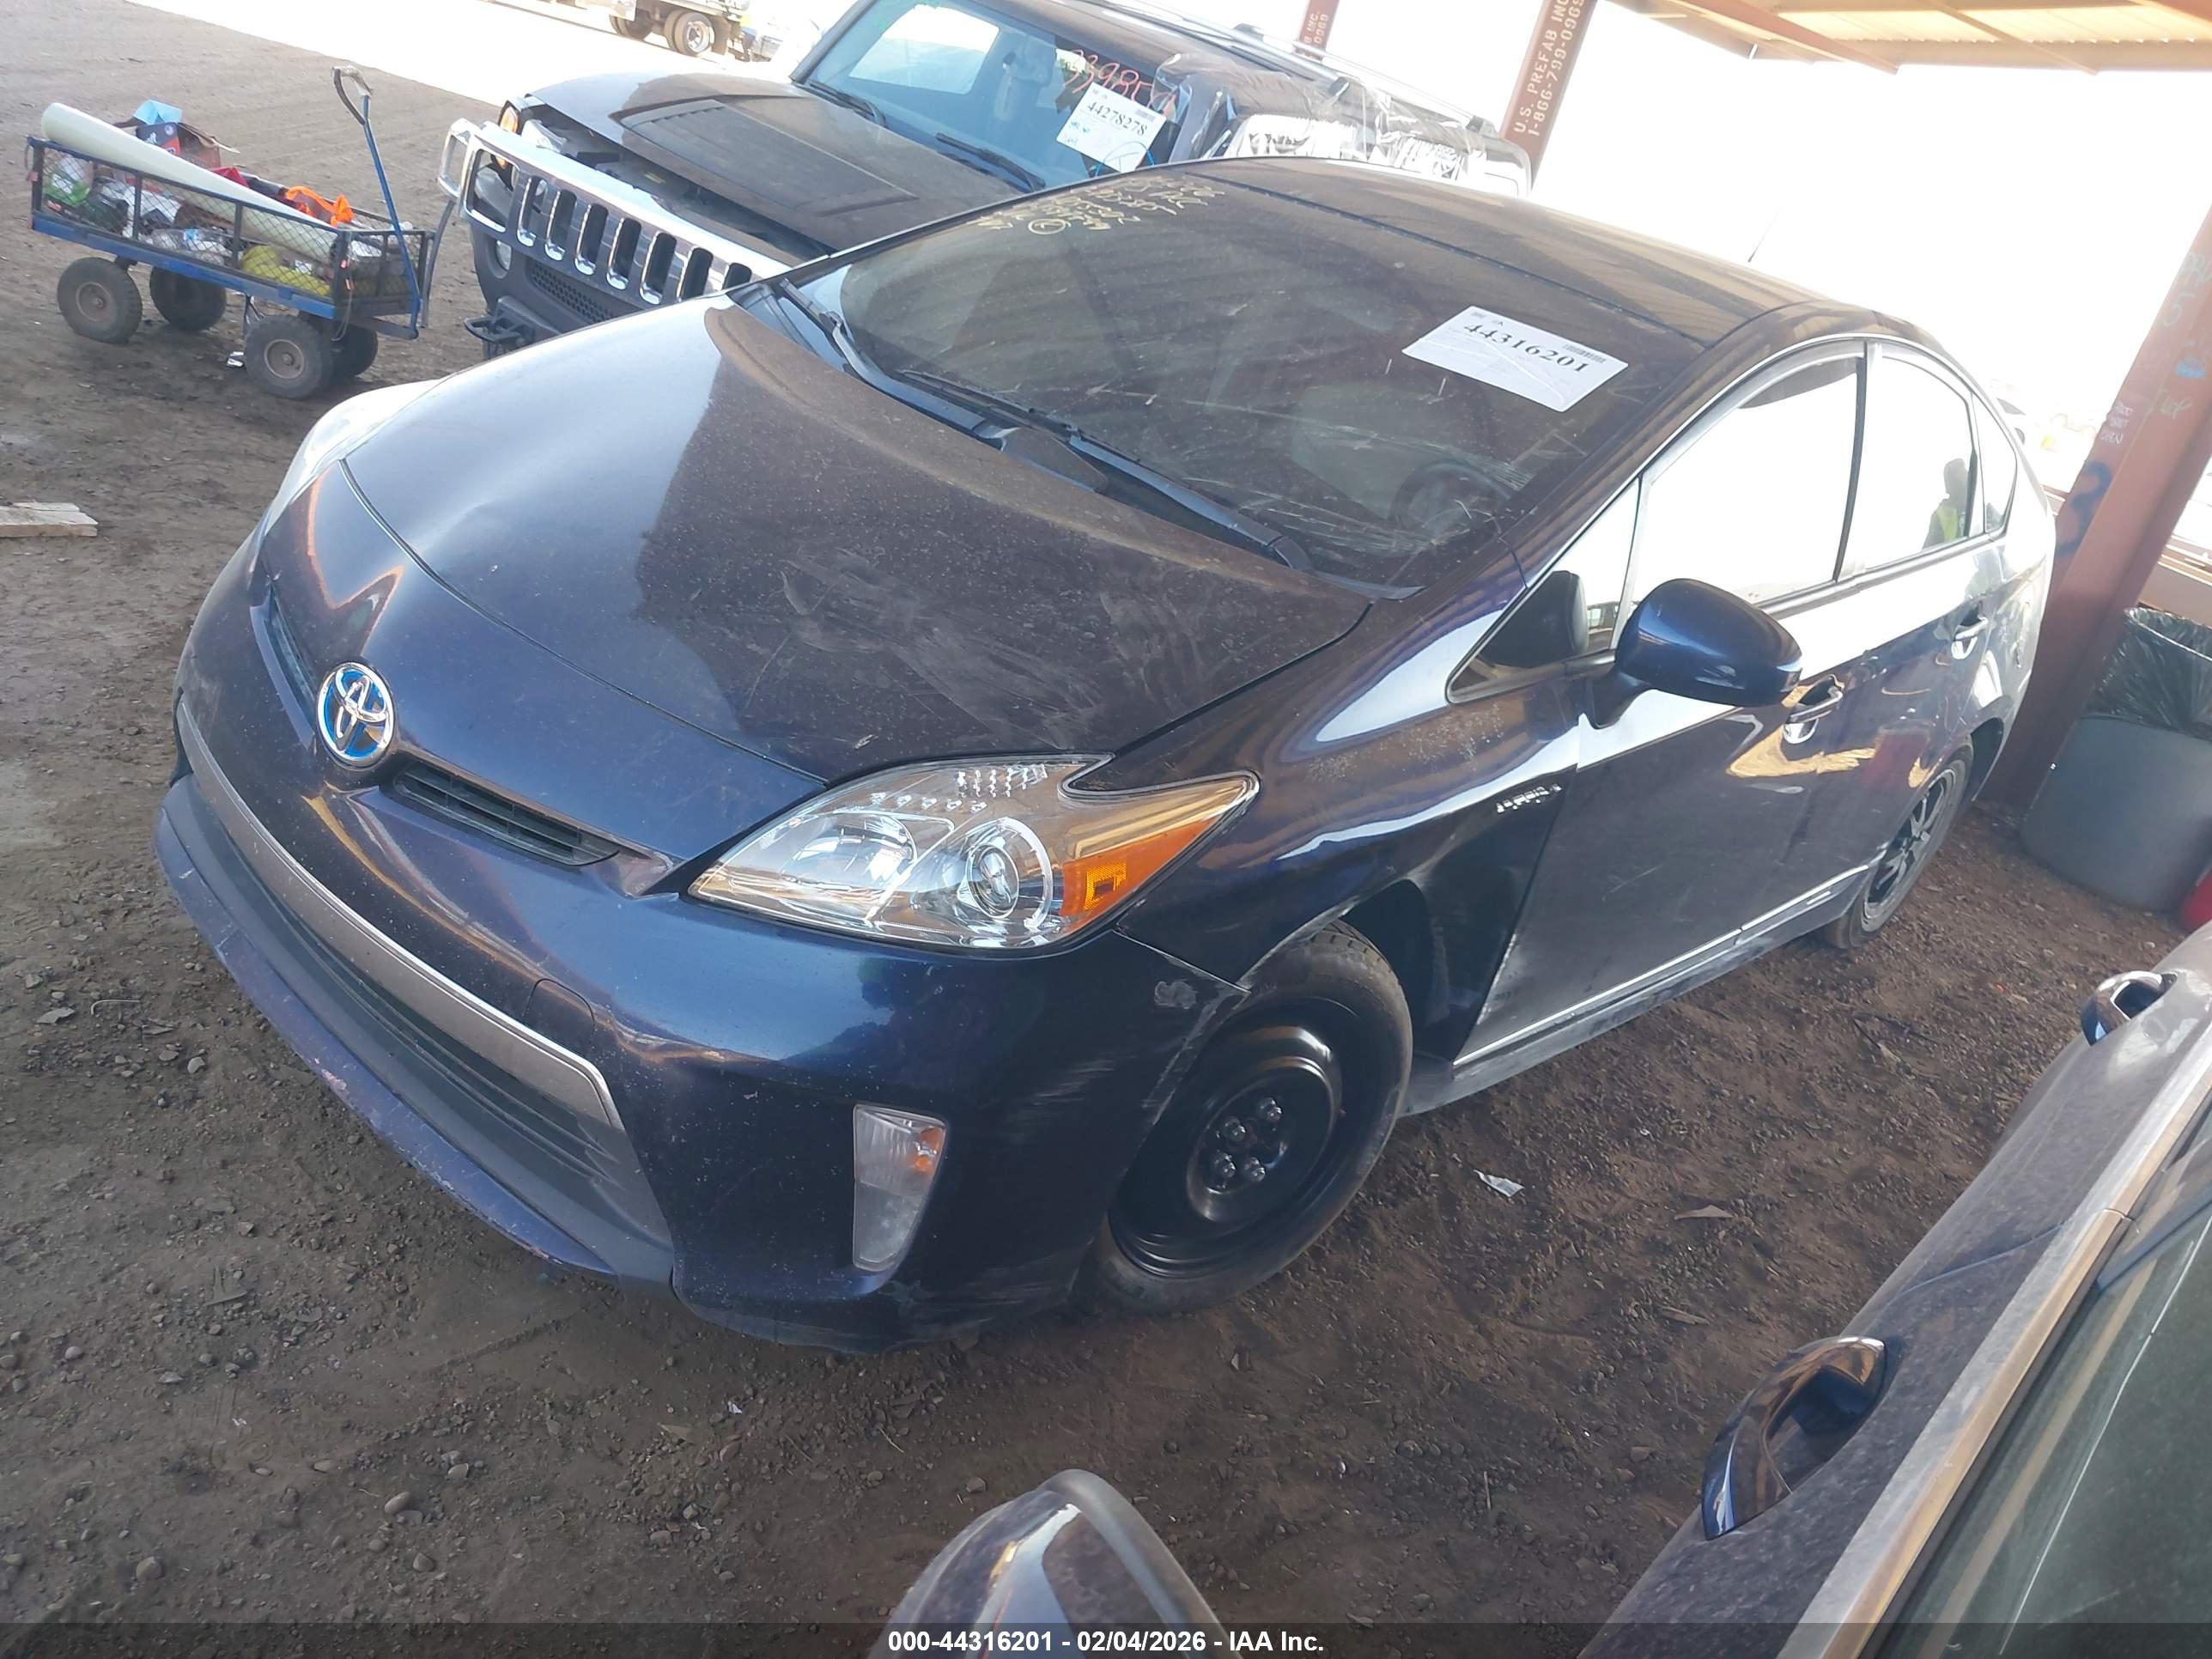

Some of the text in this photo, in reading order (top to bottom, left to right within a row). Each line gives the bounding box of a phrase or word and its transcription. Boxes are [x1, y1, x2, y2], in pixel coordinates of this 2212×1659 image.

[1514, 103, 1534, 133] U.S.
[1527, 29, 1558, 94] PREFAB
[1086, 101, 1148, 136] 44278278
[1463, 324, 1589, 373] 44316201
